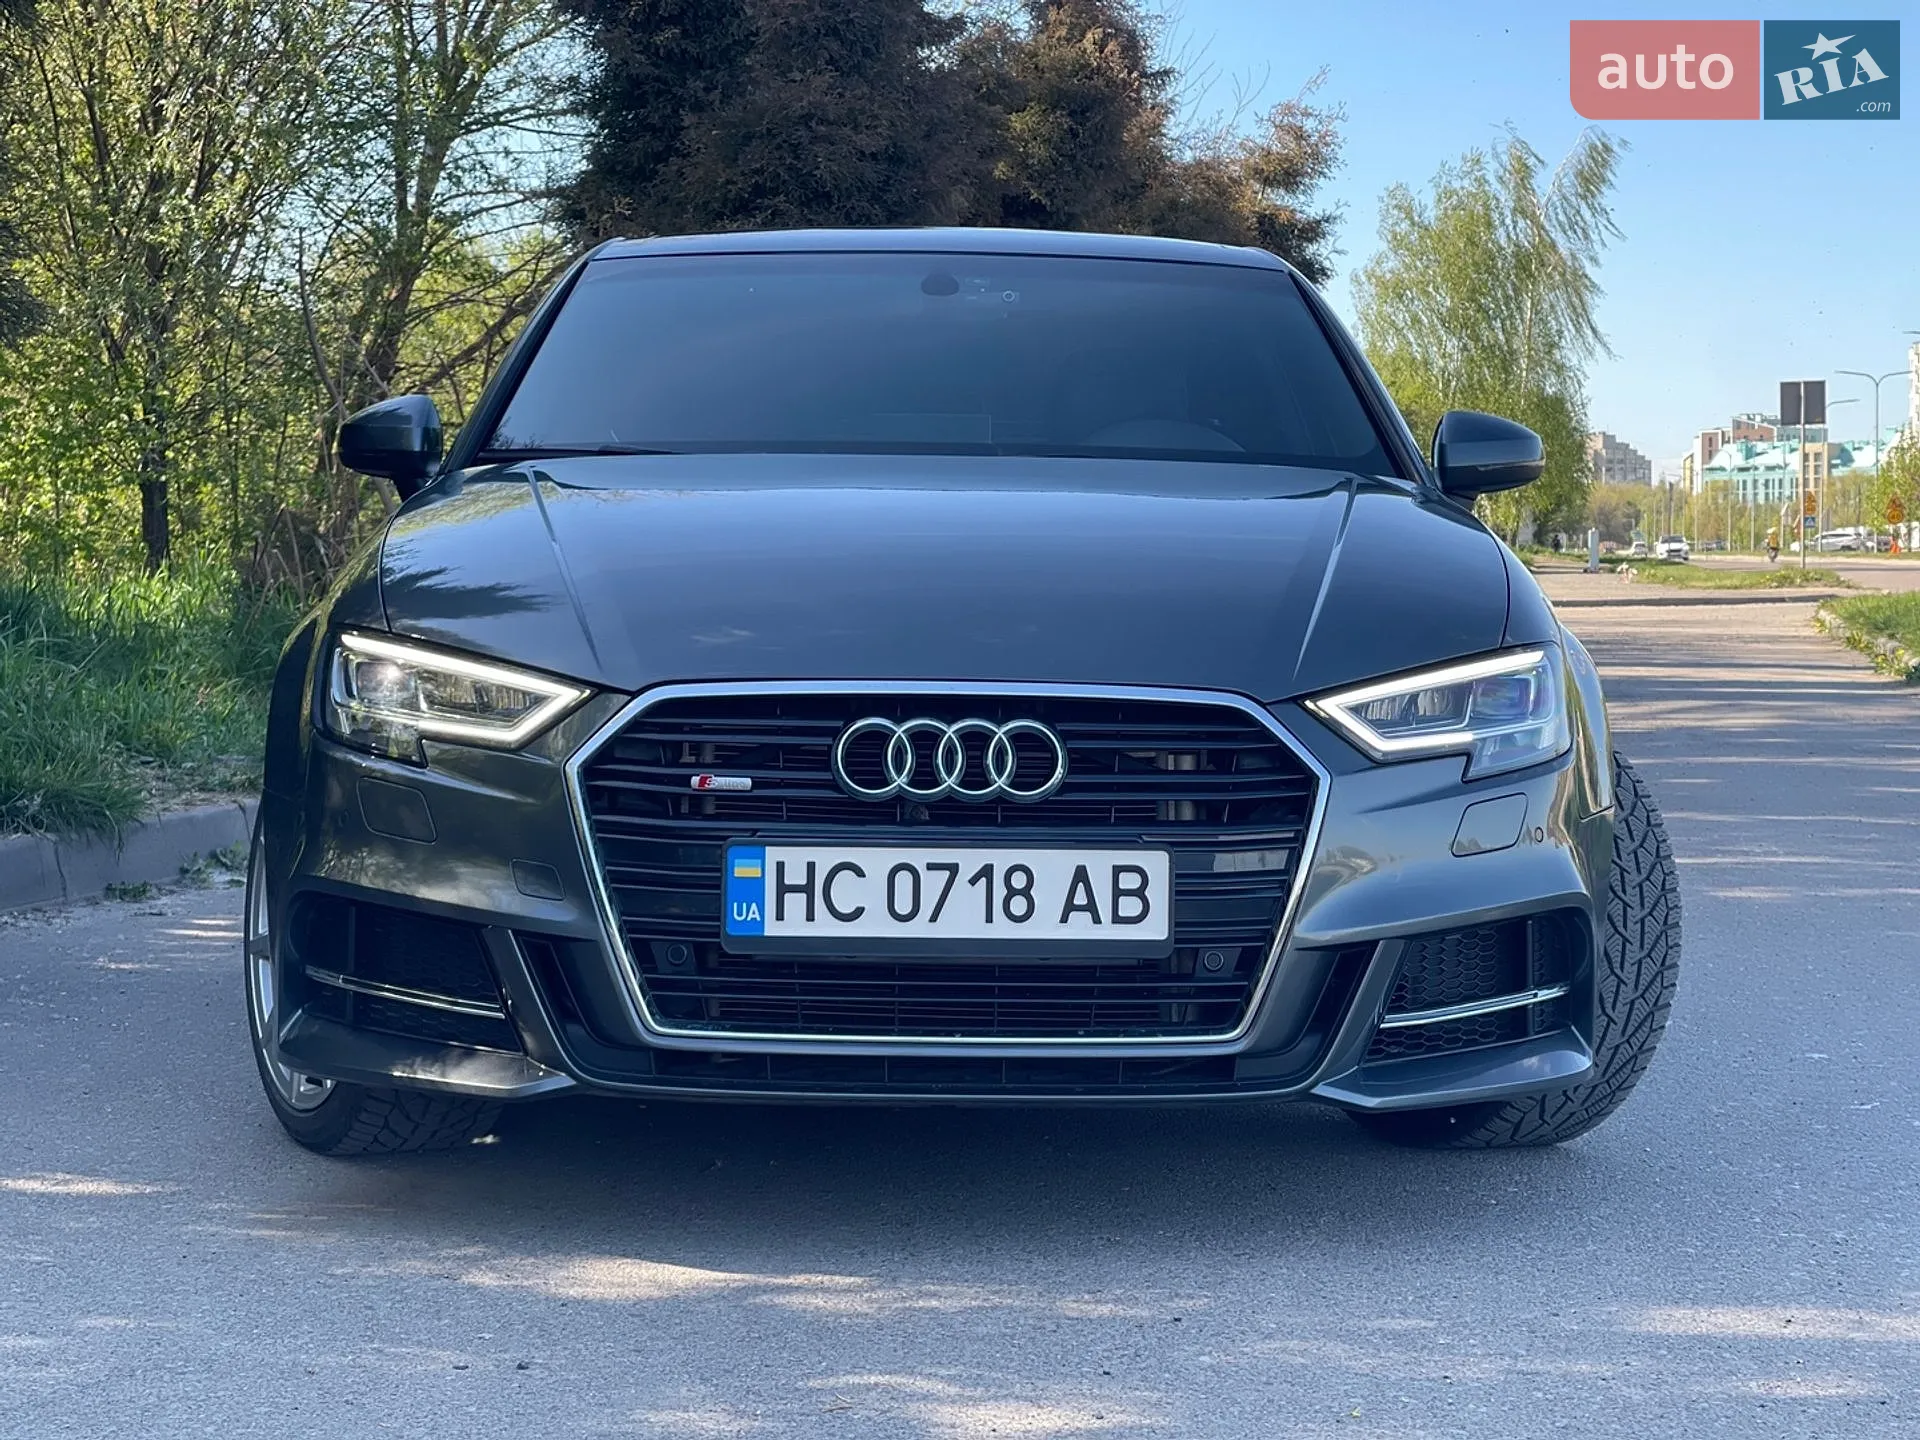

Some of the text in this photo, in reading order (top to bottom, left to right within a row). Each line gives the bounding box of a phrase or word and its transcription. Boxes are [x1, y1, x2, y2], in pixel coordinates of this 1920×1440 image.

[733, 902, 761, 921] UA
[775, 860, 1151, 925] HC 0718 AB
